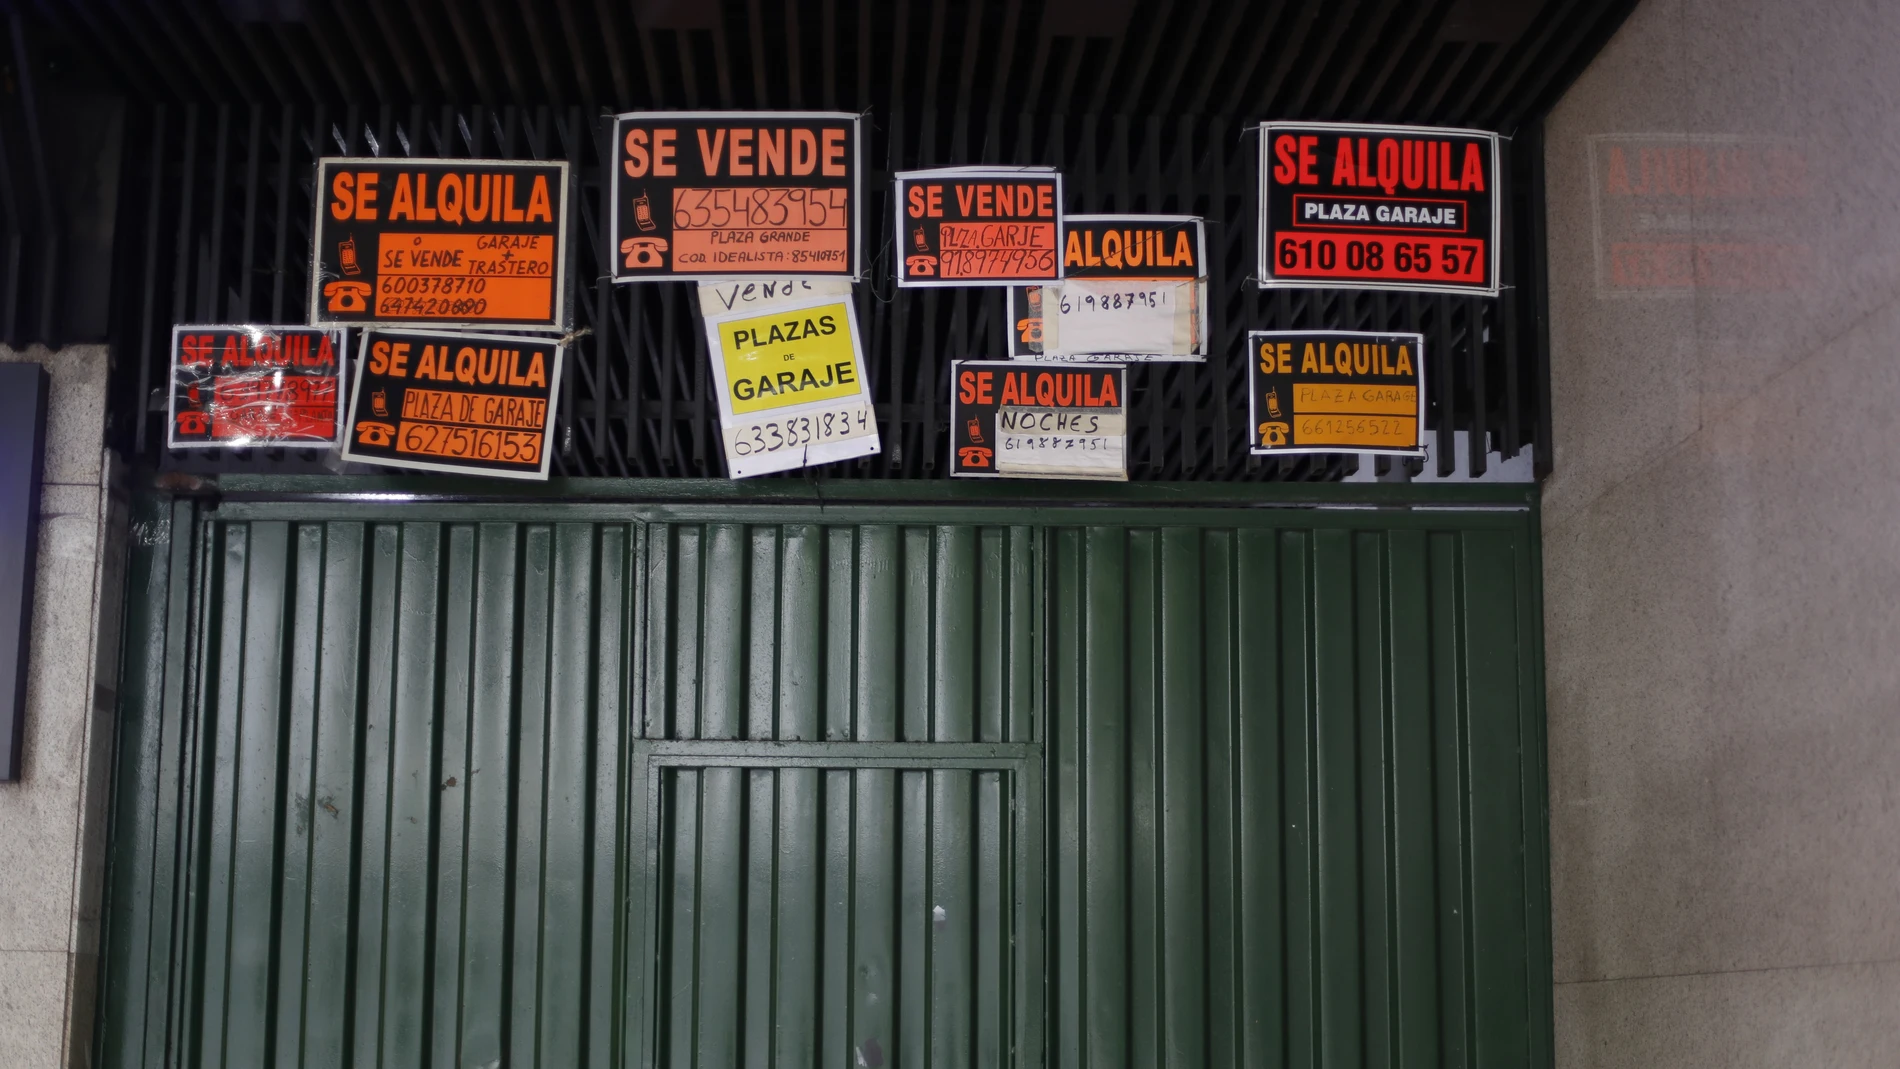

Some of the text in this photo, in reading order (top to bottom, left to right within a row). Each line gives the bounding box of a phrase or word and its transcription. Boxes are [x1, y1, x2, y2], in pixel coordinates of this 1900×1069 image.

[624, 128, 846, 177] SE VENDE
[1274, 135, 1484, 195] SE ALQUILA
[331, 171, 553, 226] SE ALQUILA
[674, 188, 847, 229] 635483954
[908, 185, 1053, 218] SE VENDE
[1305, 203, 1456, 225] PLAZA GARAJE
[477, 235, 540, 250] GARAJE
[711, 231, 811, 245] PLAZA GRANDE
[1064, 230, 1193, 269] ALQUILA
[383, 250, 464, 268] SE VENDE
[468, 260, 549, 275] TRASTERO
[1279, 238, 1479, 275] 610 08 65 57
[382, 277, 486, 295] 600378710
[1060, 292, 1166, 314] 619887951
[733, 315, 837, 350] PLAZAS
[181, 334, 334, 367] SE ALQUILA
[369, 341, 546, 388] SE ALQUILA
[783, 353, 795, 362] DE
[1260, 343, 1413, 376] SE ALQUILA
[733, 361, 854, 401] GARAJE
[959, 371, 1118, 407] SE ALQUILA
[1300, 387, 1357, 404] PLAZA
[403, 391, 545, 428] PLAZA DE GARAJE
[1002, 412, 1098, 433] NOCHES
[405, 425, 537, 462] 627516153
[735, 410, 867, 455] 633831834
